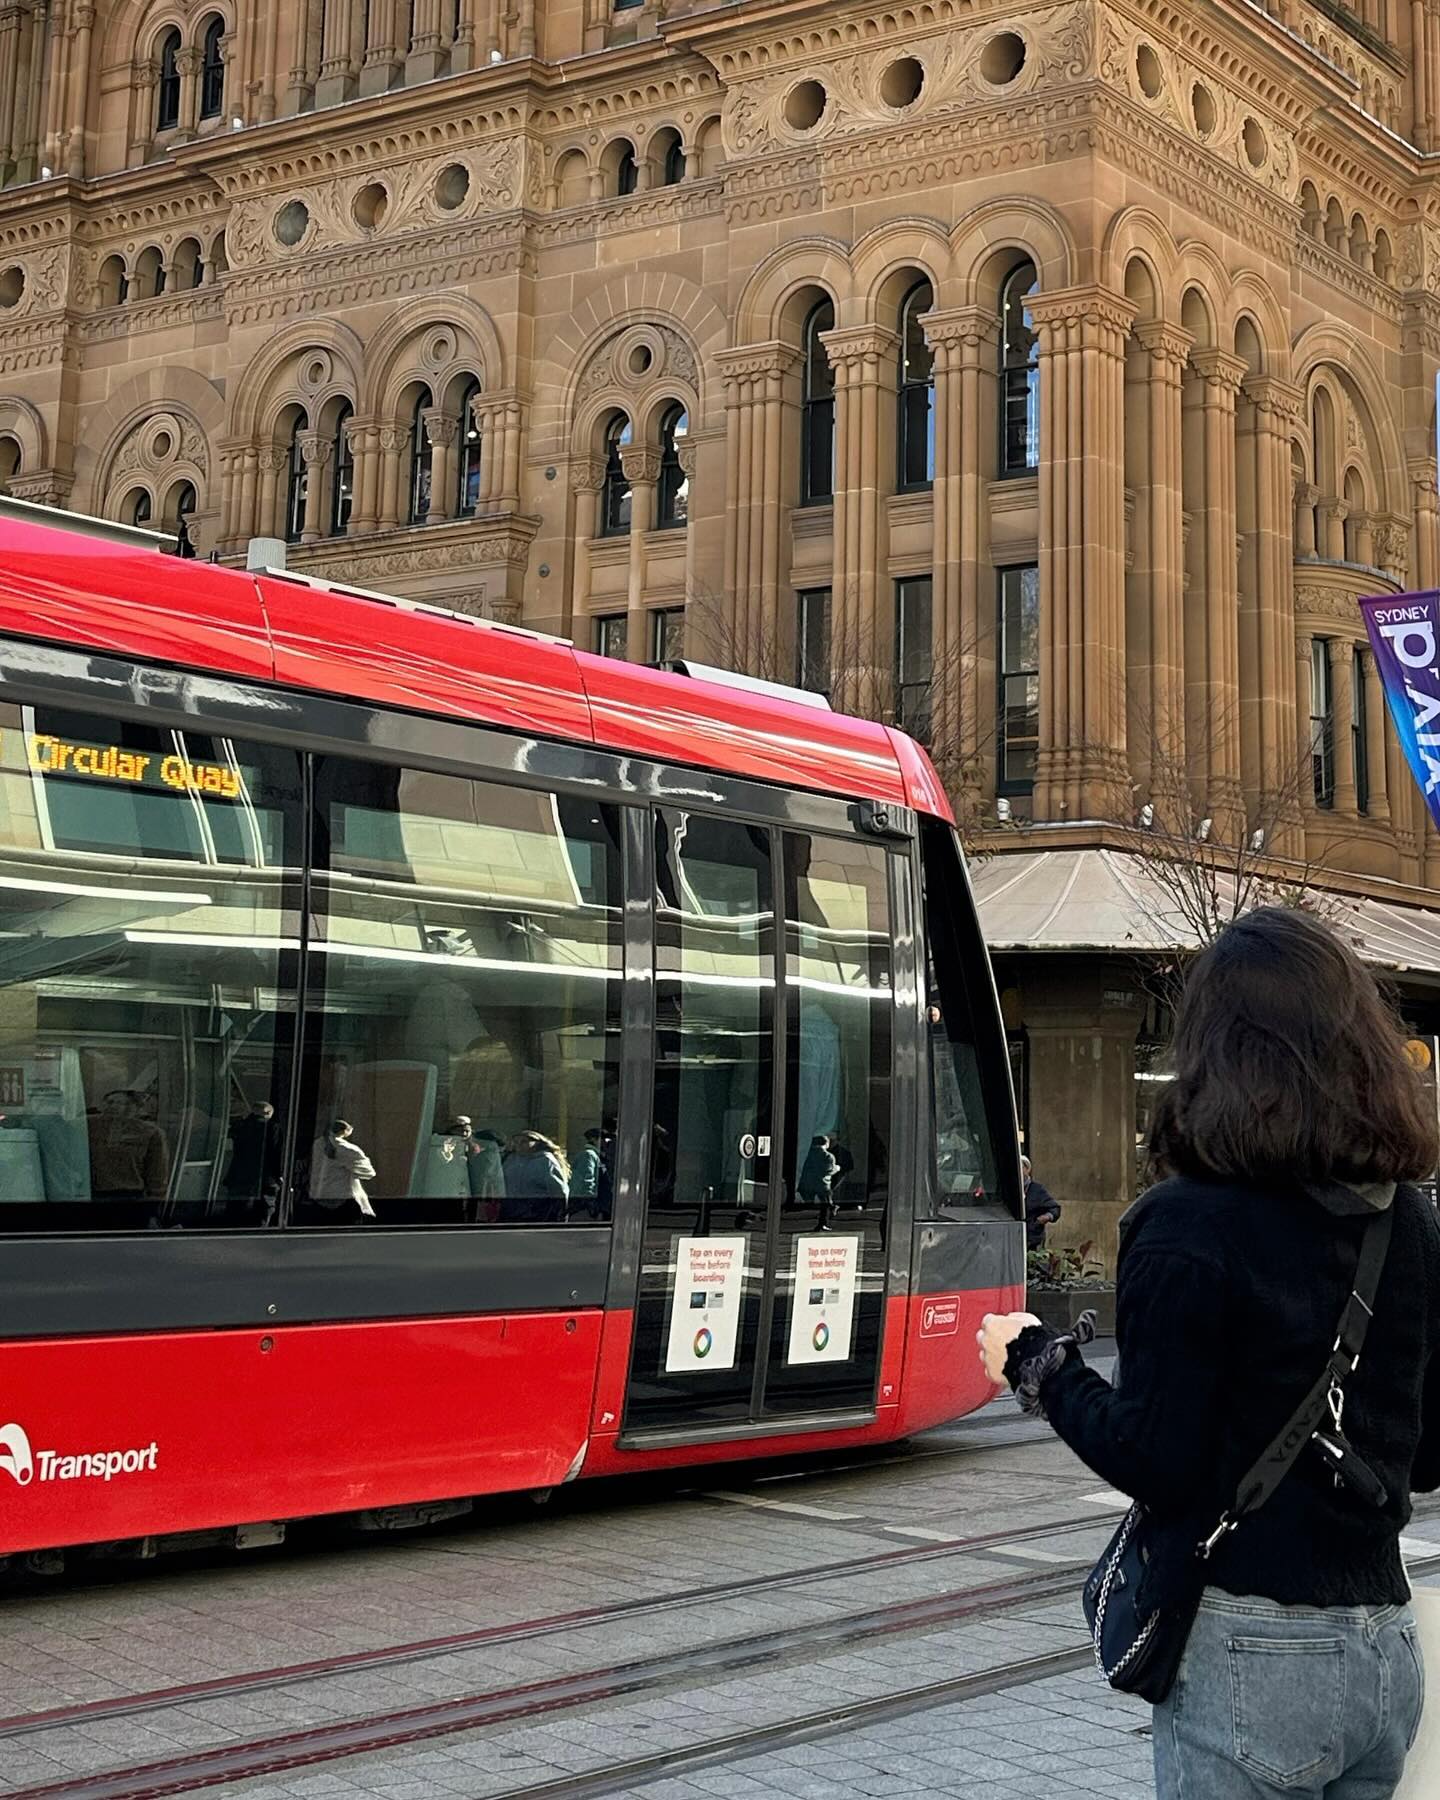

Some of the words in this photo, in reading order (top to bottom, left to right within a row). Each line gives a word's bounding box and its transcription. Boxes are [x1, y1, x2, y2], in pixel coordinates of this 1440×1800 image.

[1374, 605, 1429, 623] SYDNEY
[28, 733, 149, 781] Circular
[160, 755, 241, 797] Quay
[714, 1249, 734, 1259] every
[708, 1260, 731, 1270] before
[693, 1272, 726, 1284] boarding
[811, 1270, 841, 1282] boarding
[36, 1441, 159, 1482] Transport
